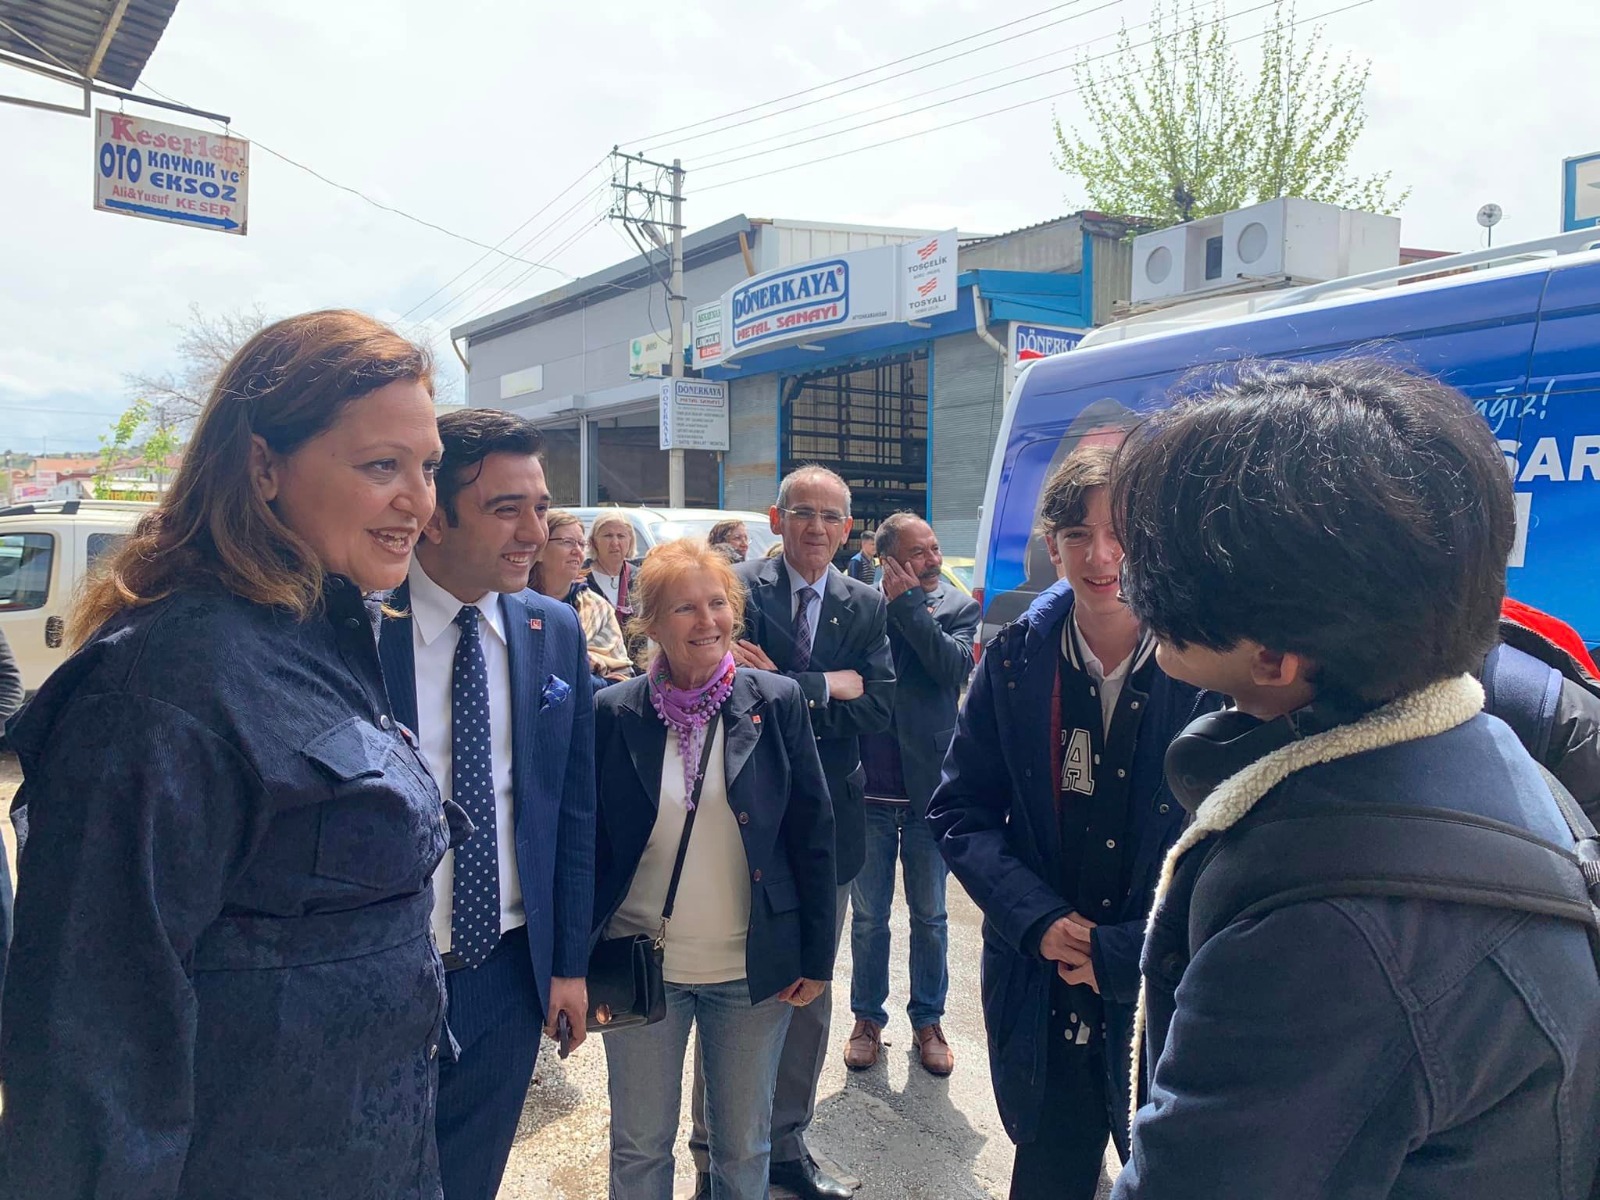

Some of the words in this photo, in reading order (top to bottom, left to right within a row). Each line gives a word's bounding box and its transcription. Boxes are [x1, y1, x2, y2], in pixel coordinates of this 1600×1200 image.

[110, 116, 240, 163] Keserler
[100, 142, 142, 183] OTO
[147, 149, 216, 179] KAYNAK
[220, 169, 240, 183] ve
[112, 184, 170, 205] Ali&Yusuf
[176, 197, 232, 216] KESER
[150, 172, 237, 202] EKSOZ
[907, 256, 947, 273] TOSÇELİK
[735, 270, 839, 319] DÖNERKAYA
[908, 294, 947, 309] TOSYALI
[737, 321, 771, 340] METAL
[776, 303, 838, 328] SANAYİ
[1018, 329, 1080, 354] DÖNERKA
[1474, 379, 1556, 434] ağız!
[1499, 435, 1600, 482] SAR
[1061, 728, 1095, 796] A
